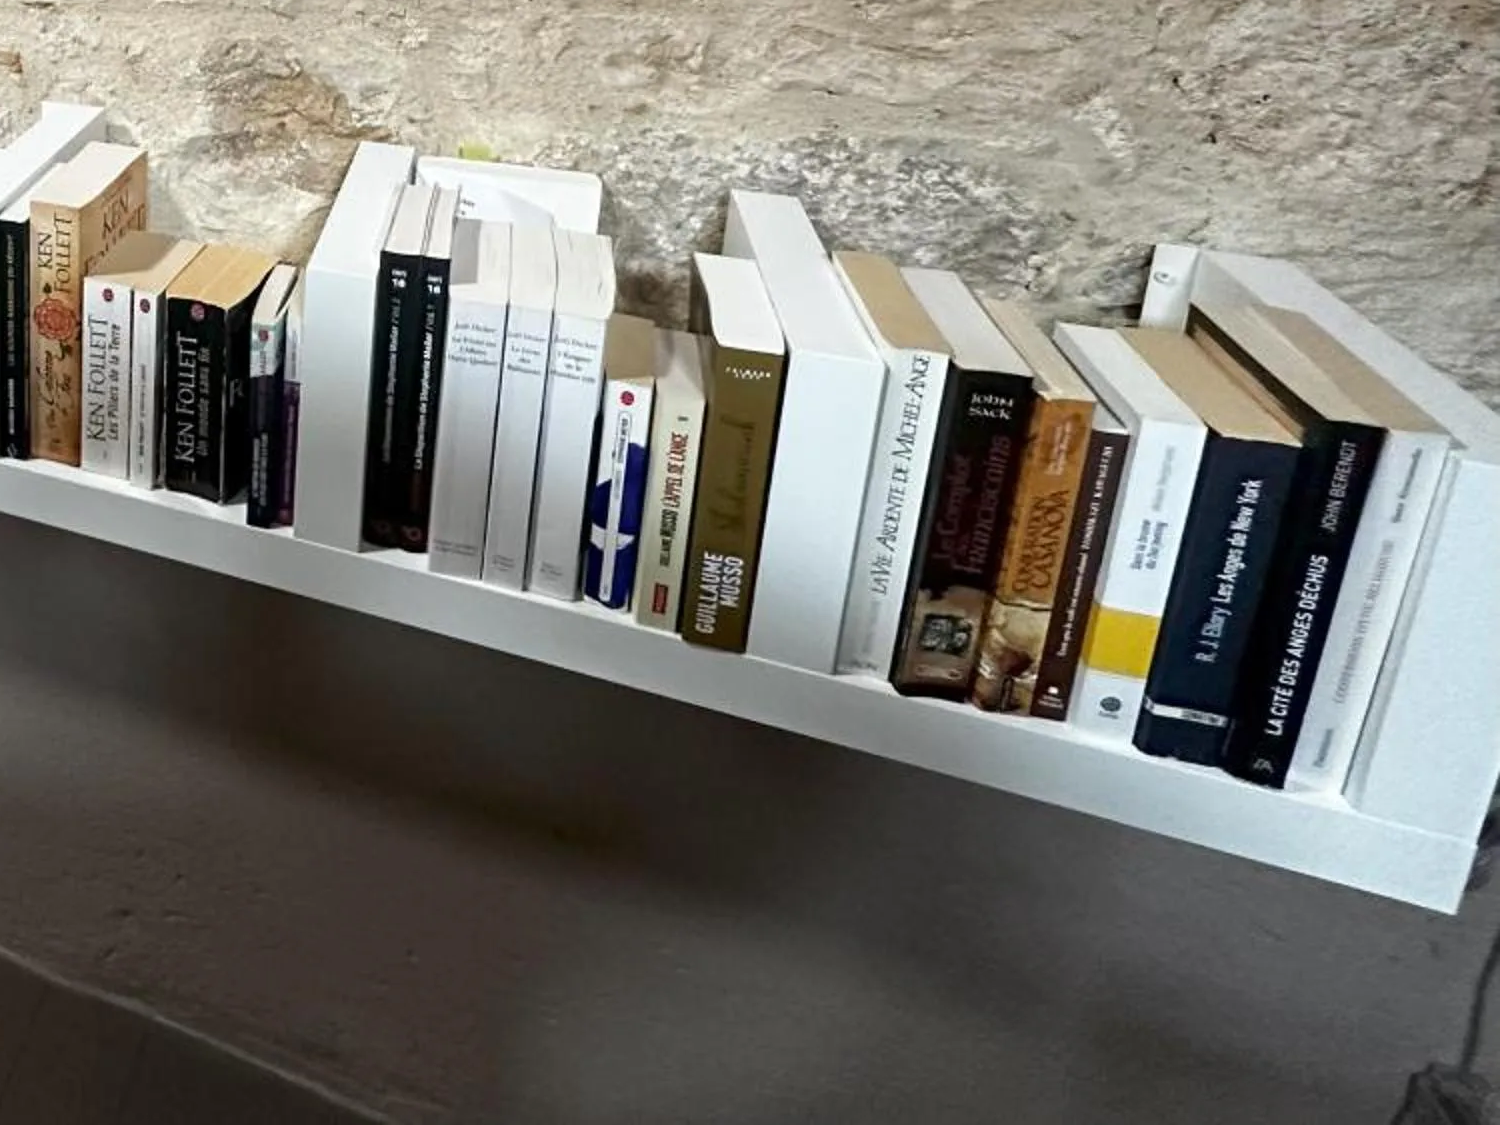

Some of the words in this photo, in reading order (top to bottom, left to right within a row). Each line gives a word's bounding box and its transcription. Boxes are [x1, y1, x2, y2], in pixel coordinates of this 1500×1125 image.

[38, 231, 54, 270] KEN
[54, 212, 74, 295] FOLLETT
[111, 323, 122, 350] Terre
[88, 314, 109, 398] FOLLETT
[111, 353, 120, 365] la
[176, 330, 199, 416] FOLLETT
[110, 369, 120, 383] de
[109, 384, 121, 419] Piliers
[892, 354, 931, 462] MICHEL-ANGE
[86, 401, 107, 444] KEN
[108, 420, 120, 441] Les
[174, 423, 195, 463] KEN
[894, 465, 910, 484] DE
[1329, 439, 1357, 501] BERENDT
[1240, 479, 1264, 505] York
[876, 482, 904, 554] ARDENTE
[1230, 502, 1255, 534] New
[1321, 499, 1340, 534] JOHN
[1030, 489, 1070, 590] CASANOVA
[1227, 531, 1251, 549] de
[719, 555, 744, 609] MUSSO
[871, 553, 893, 577] VIE
[1215, 547, 1248, 585] Anges
[1294, 552, 1331, 612] DÉCHUS
[695, 551, 723, 635] GUILLAUME
[871, 573, 888, 596] LA
[1209, 581, 1235, 604] Les
[1286, 608, 1315, 659] ANGES
[1278, 654, 1302, 688] DES
[1270, 684, 1293, 718] CITÉ
[1264, 714, 1284, 737] LA
